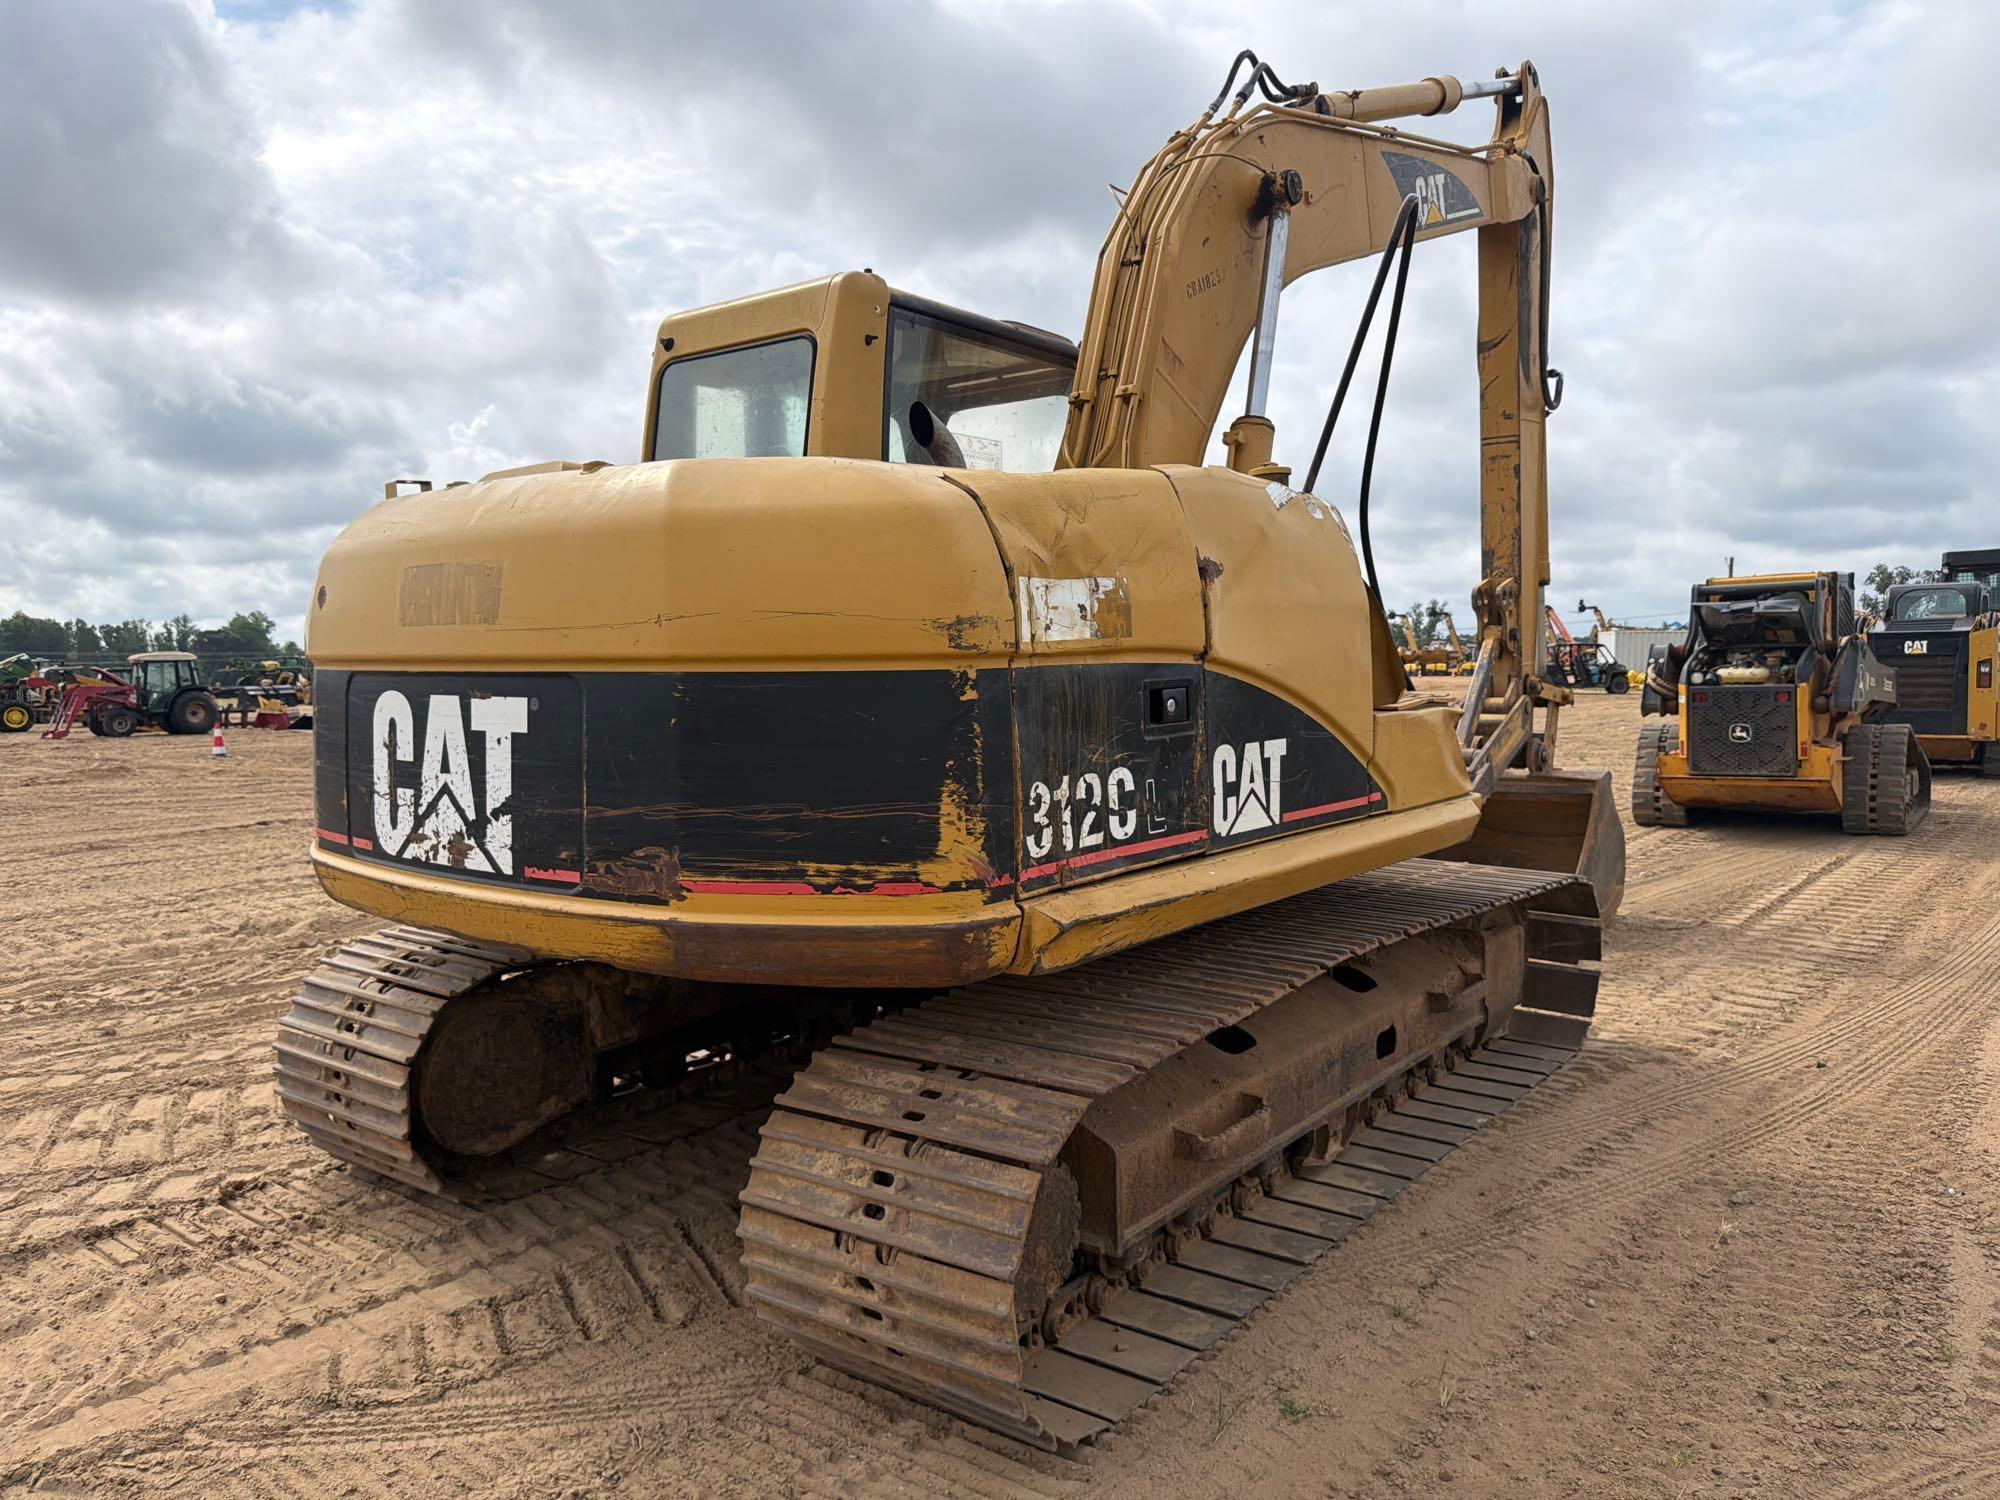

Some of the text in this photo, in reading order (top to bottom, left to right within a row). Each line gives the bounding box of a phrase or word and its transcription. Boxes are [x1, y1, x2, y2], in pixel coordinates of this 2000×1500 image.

[1415, 173, 1447, 227] CAT
[1904, 640, 1928, 654] CAT
[372, 690, 529, 876] CAT
[1025, 766, 1168, 859] 312C L
[1212, 737, 1287, 836] CAT
